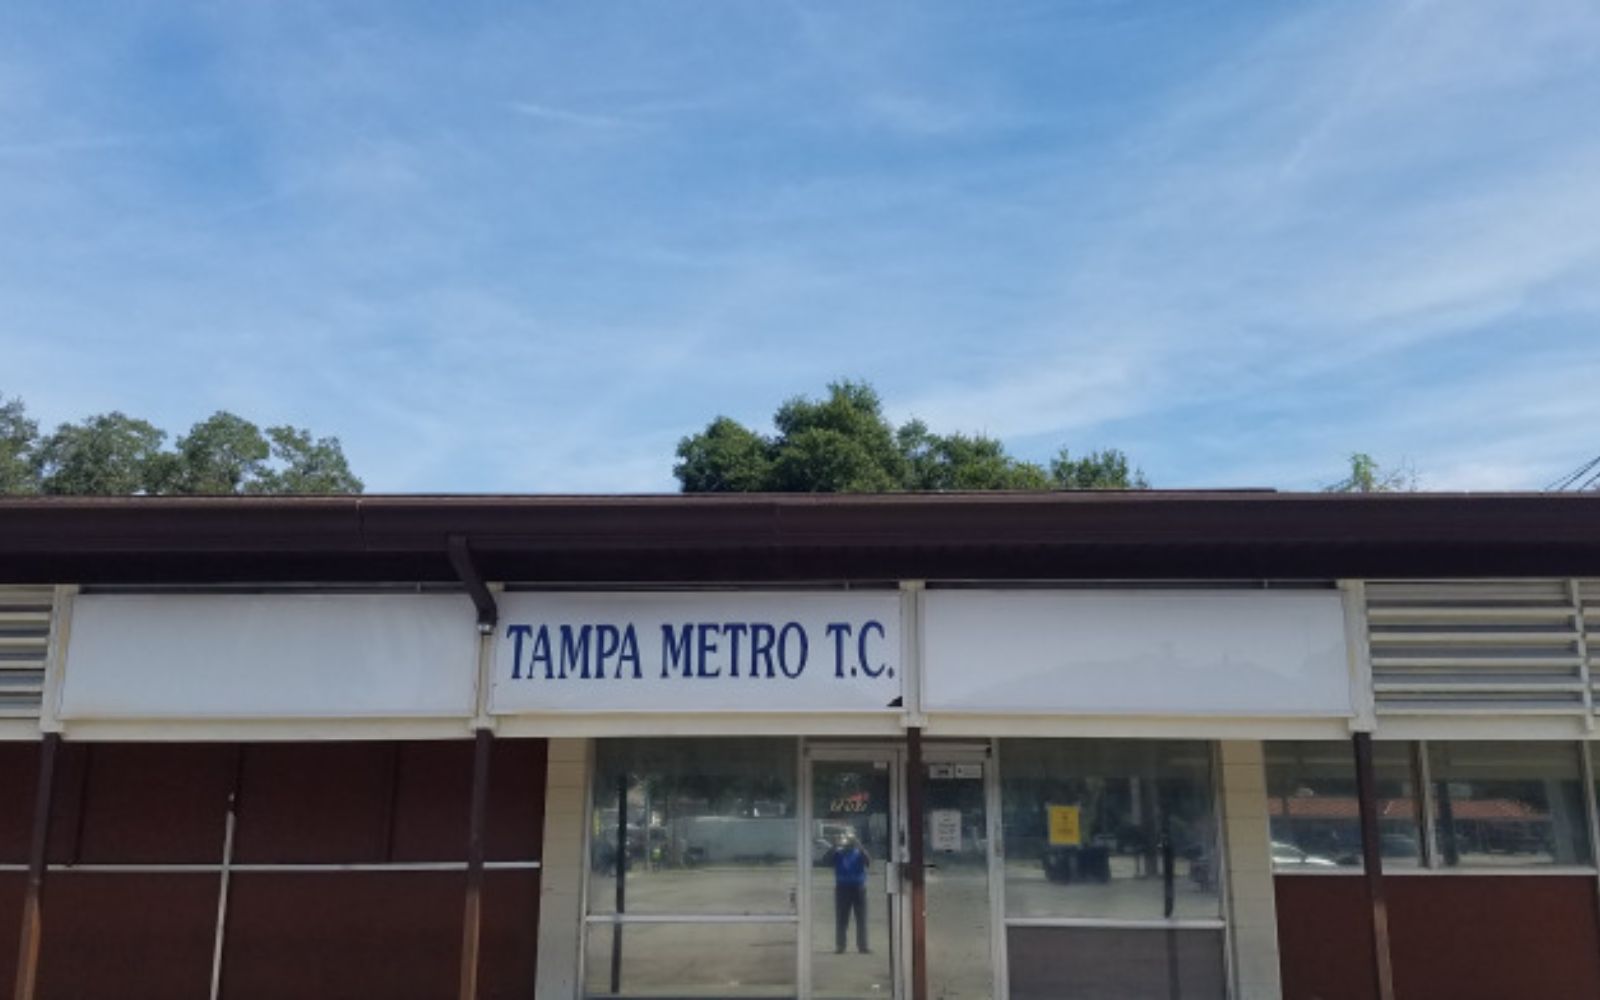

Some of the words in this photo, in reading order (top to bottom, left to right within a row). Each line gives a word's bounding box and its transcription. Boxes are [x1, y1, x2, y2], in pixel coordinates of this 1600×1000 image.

[506, 622, 643, 680] TAMPA
[660, 621, 809, 680] METRO
[826, 620, 895, 679] T.C.
